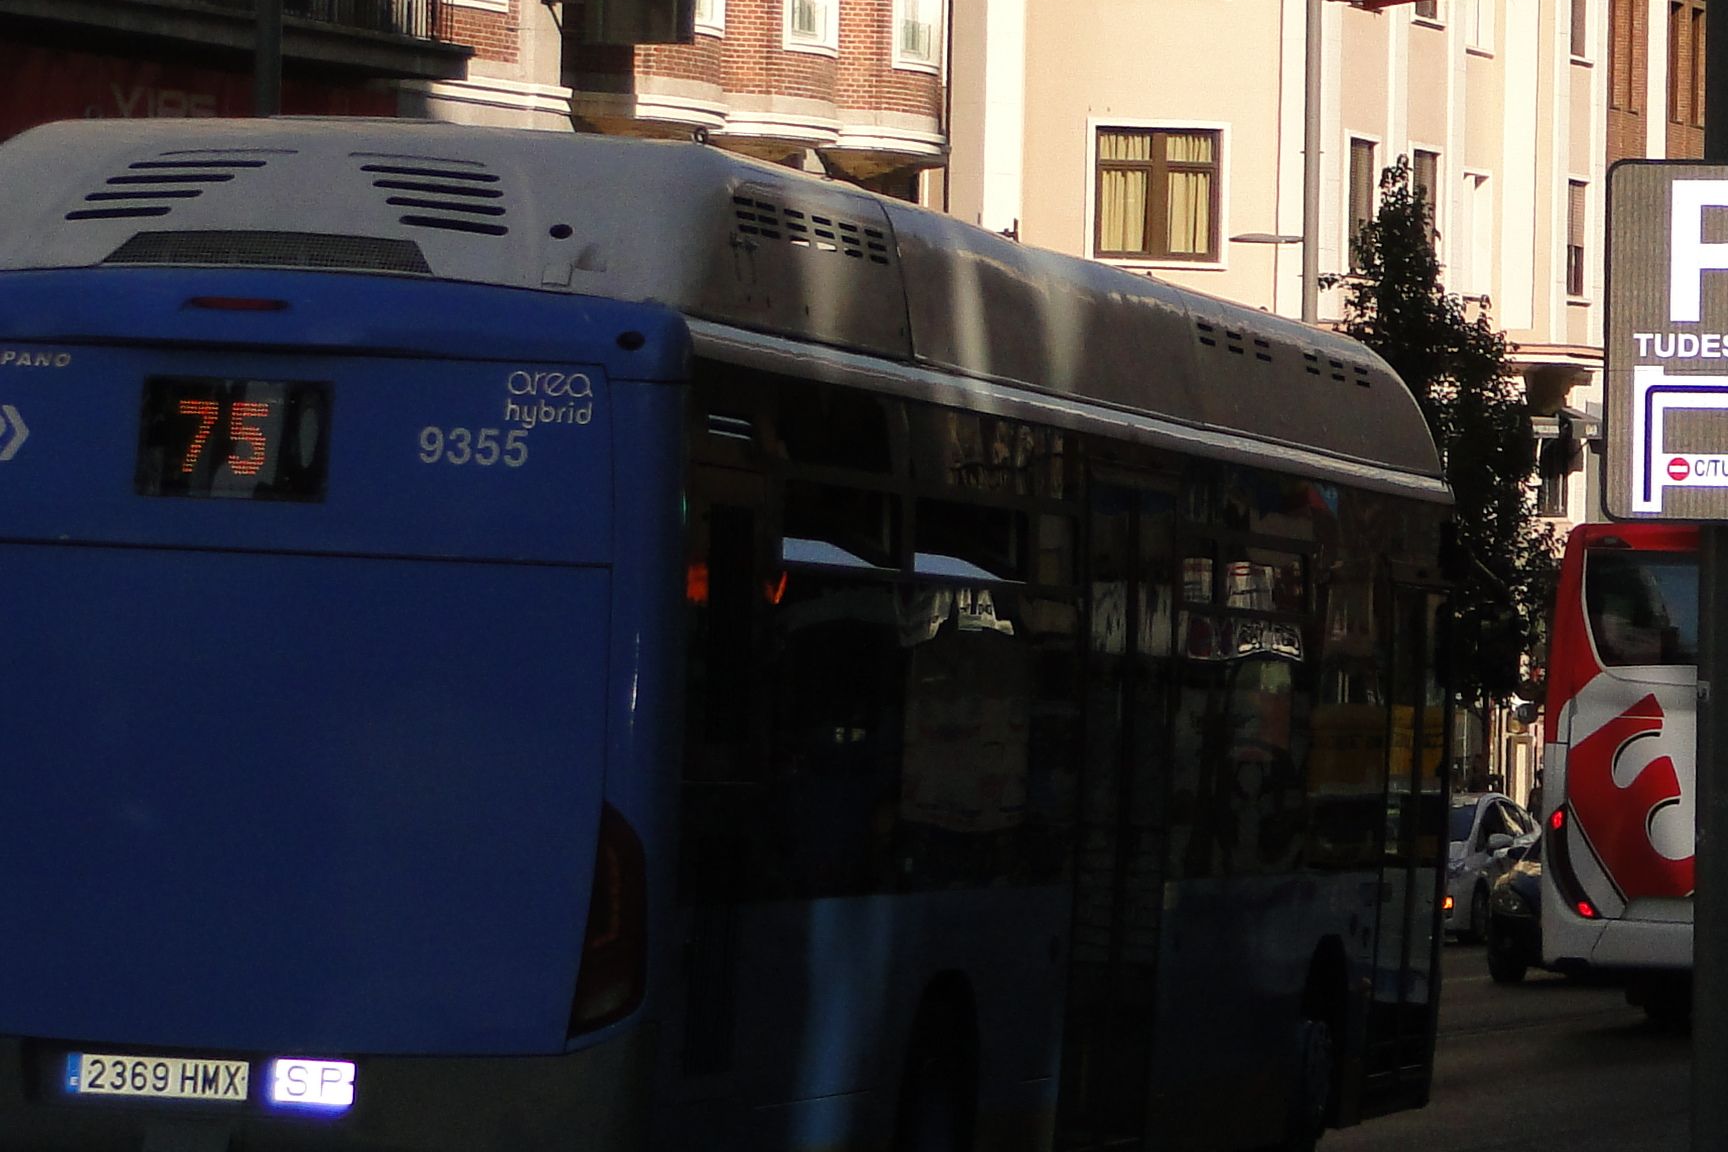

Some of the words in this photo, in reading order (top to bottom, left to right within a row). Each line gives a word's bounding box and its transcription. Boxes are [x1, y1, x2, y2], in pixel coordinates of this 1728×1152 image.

[506, 371, 593, 398] area
[504, 399, 593, 431] hybrid
[178, 399, 270, 475] 75
[418, 425, 530, 468] 9355
[88, 1059, 171, 1092] 2369
[180, 1063, 243, 1097] HMX
[286, 1065, 343, 1098] SP
